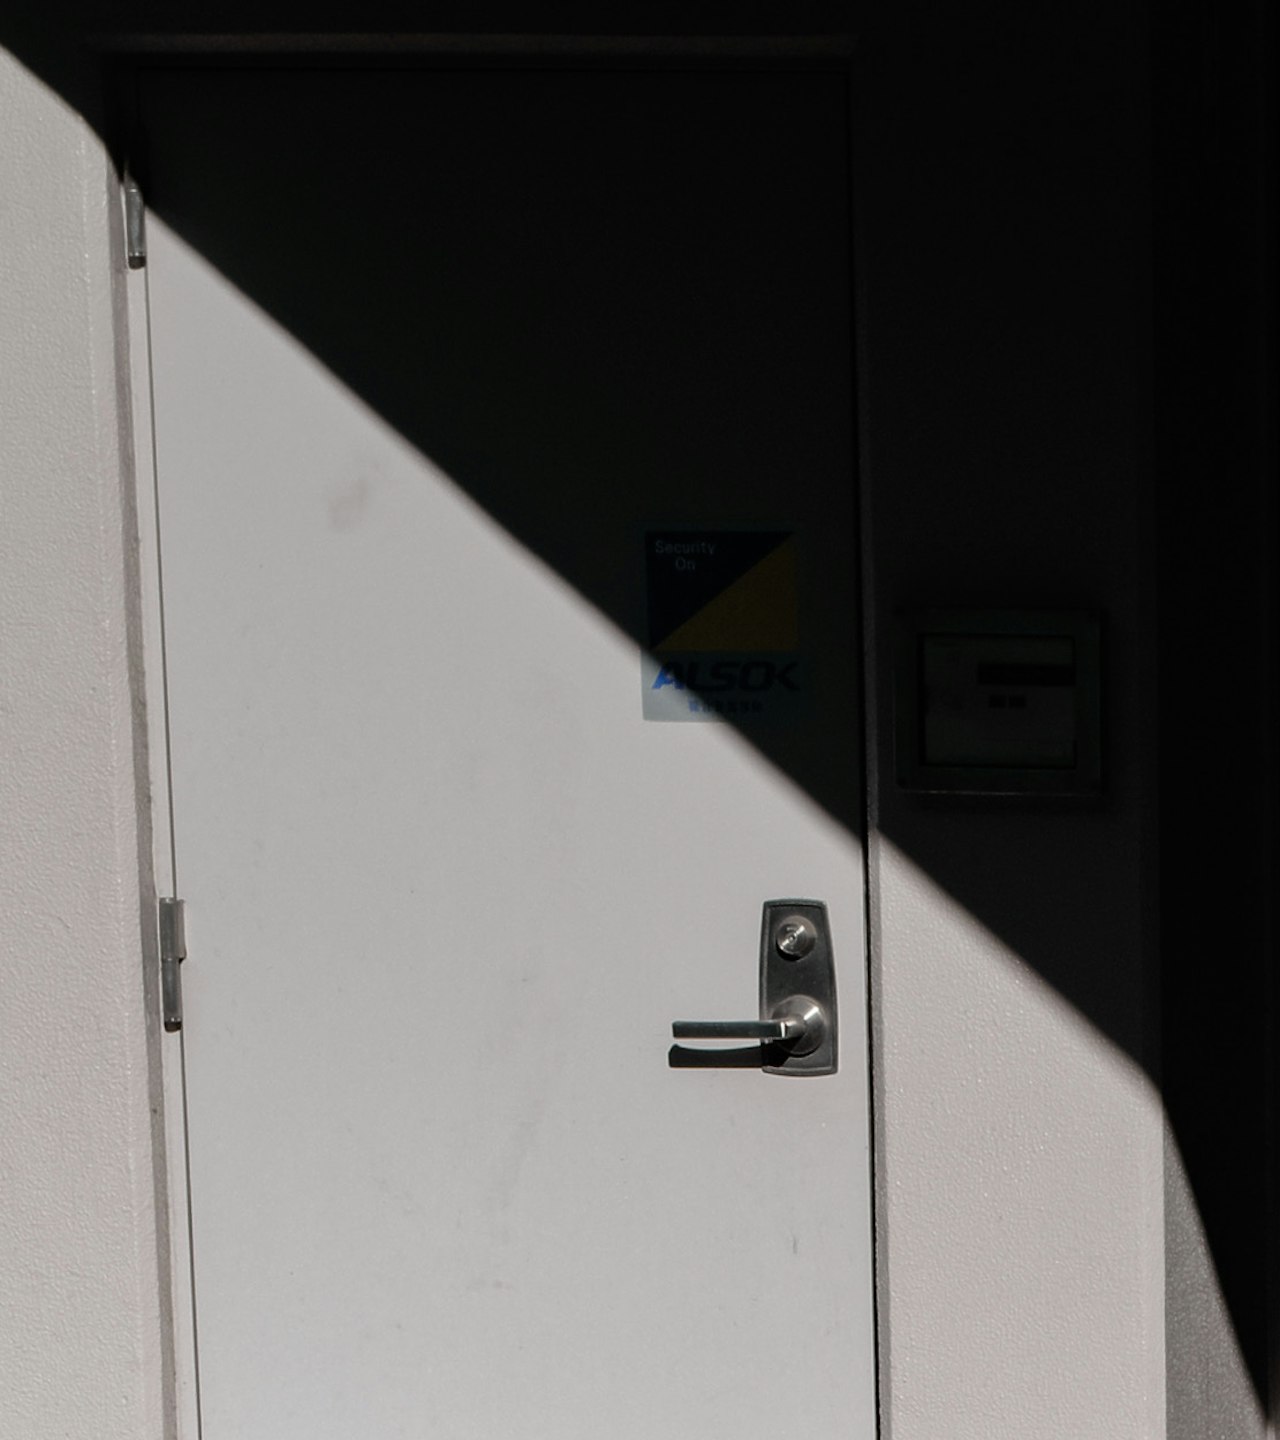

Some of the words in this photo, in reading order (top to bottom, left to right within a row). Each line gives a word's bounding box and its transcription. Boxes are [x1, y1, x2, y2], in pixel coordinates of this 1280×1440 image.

[655, 539, 717, 556] Security
[674, 556, 697, 572] On
[651, 661, 801, 692] ALSOK
